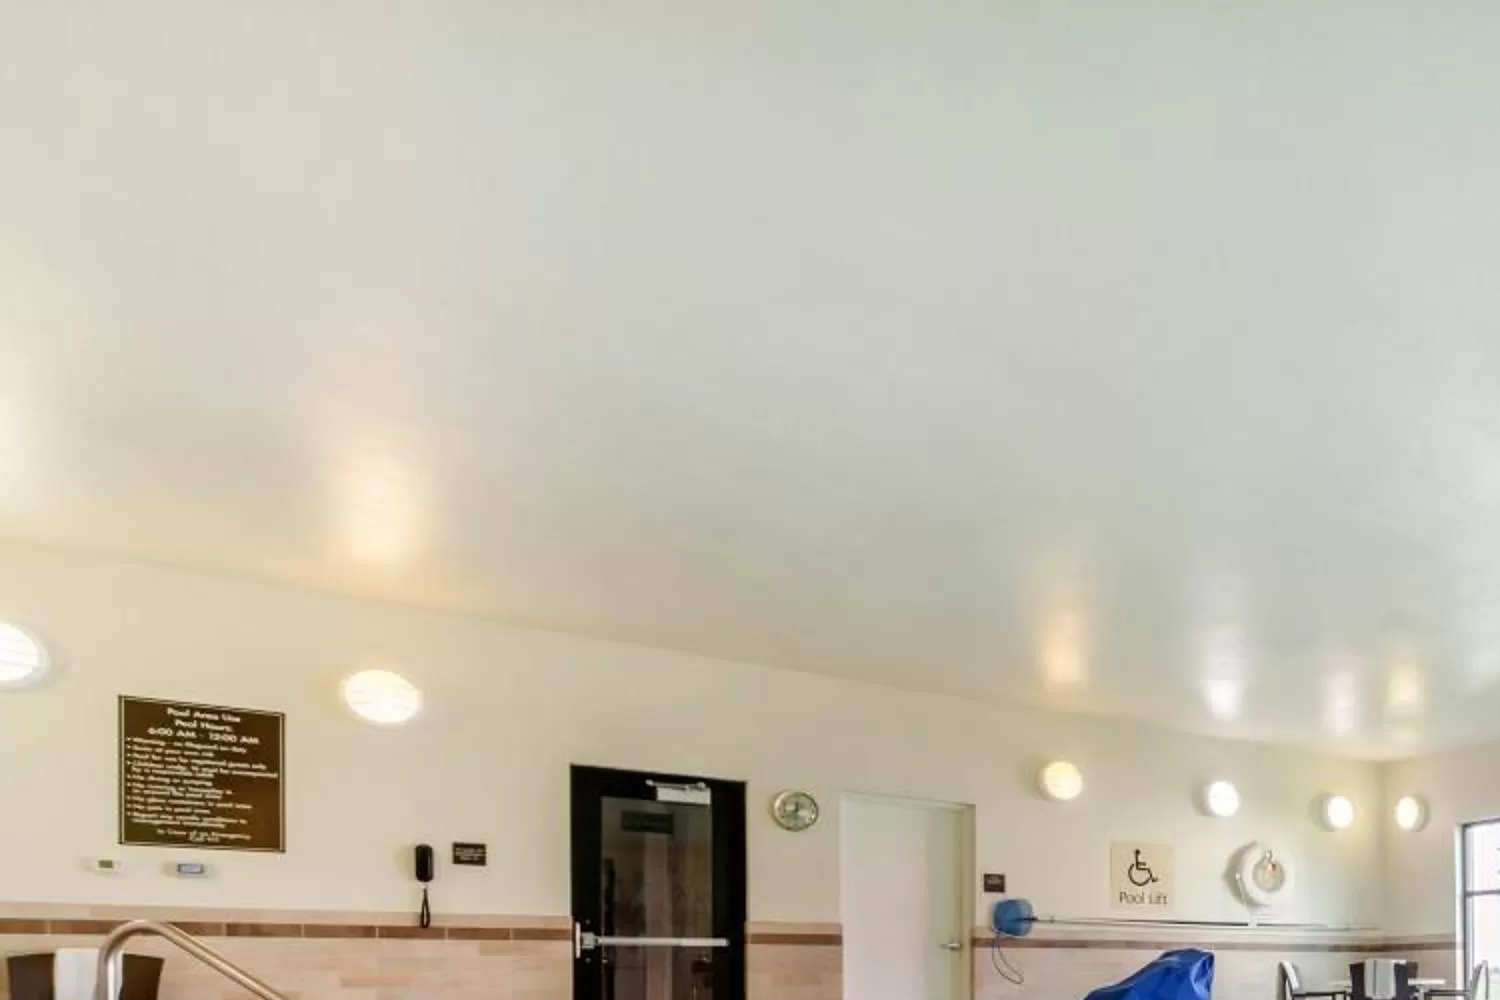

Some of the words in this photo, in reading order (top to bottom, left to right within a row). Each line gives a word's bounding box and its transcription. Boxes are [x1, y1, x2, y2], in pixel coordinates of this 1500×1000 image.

[166, 707, 190, 717] Pool
[193, 711, 219, 721] Area
[174, 719, 198, 728] Pool
[176, 730, 197, 739] AM
[239, 735, 260, 745] AM
[1119, 891, 1145, 905] Pool
